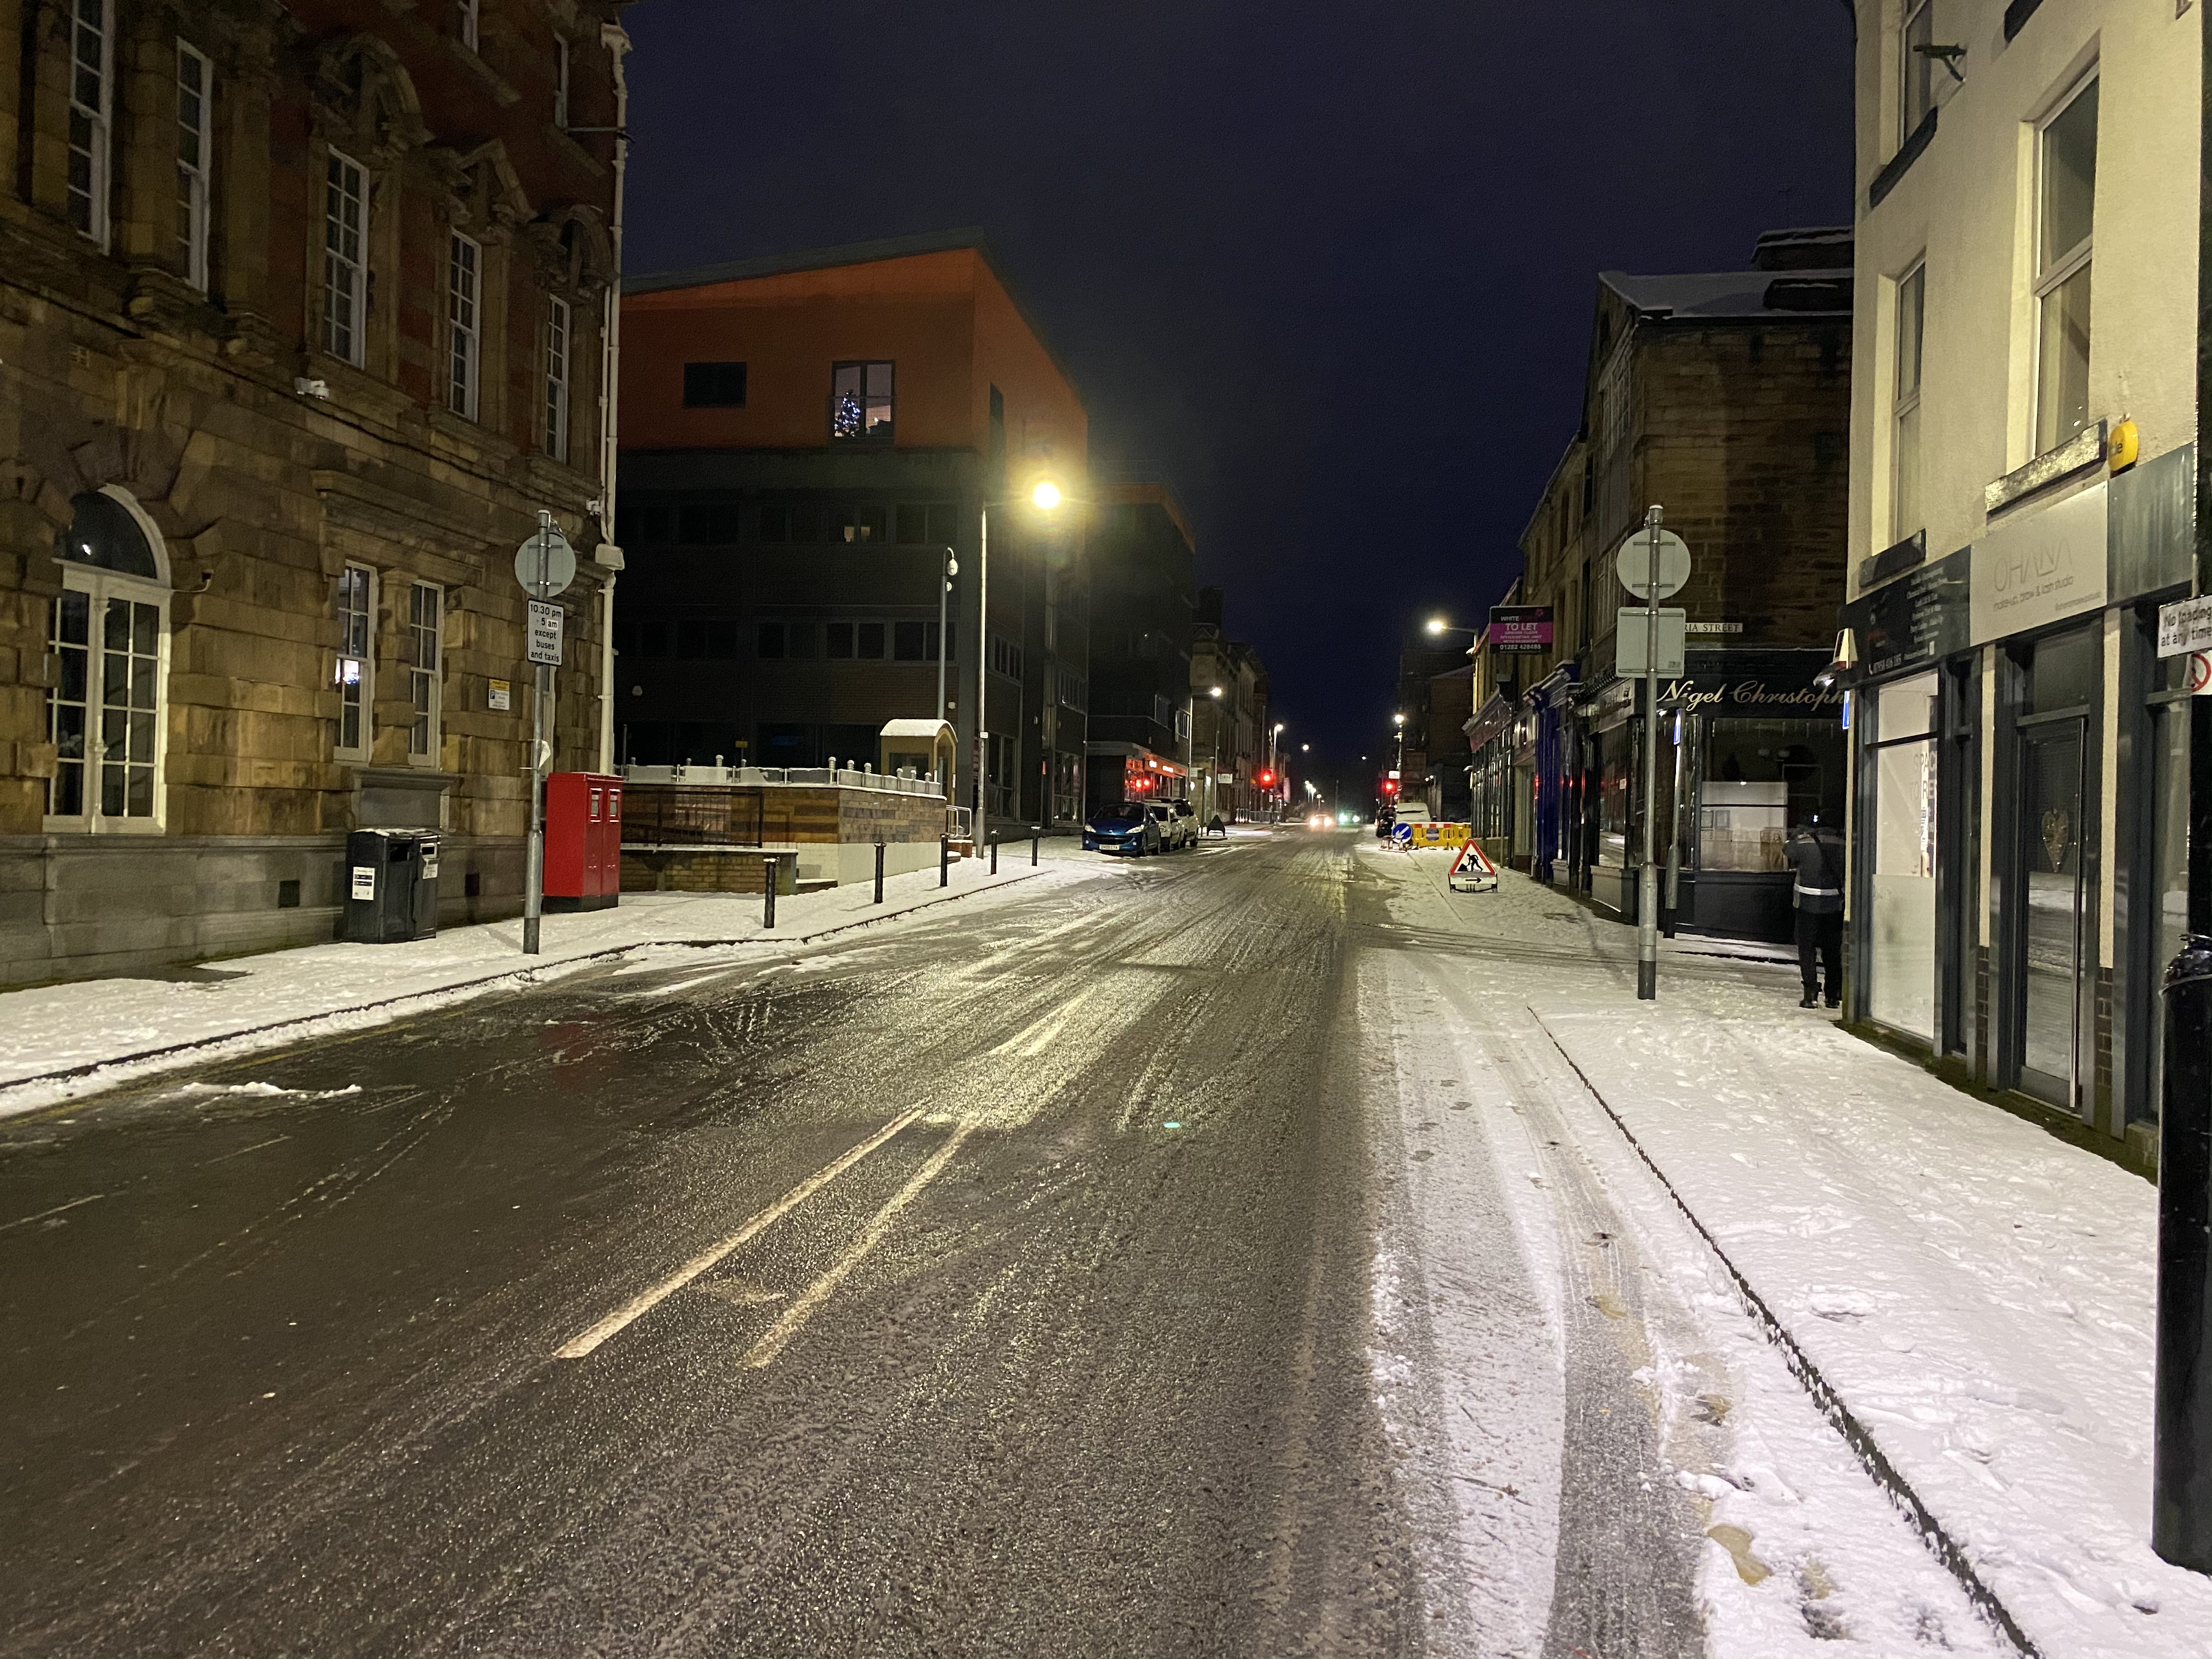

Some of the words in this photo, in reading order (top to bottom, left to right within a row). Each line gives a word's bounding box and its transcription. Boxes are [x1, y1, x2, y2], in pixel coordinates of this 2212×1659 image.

[2164, 612, 2176, 627] No
[2178, 606, 2211, 625] loading
[535, 629, 556, 639] except
[1521, 622, 1538, 630] LET
[536, 639, 555, 650] buses
[2160, 633, 2170, 647] at
[2172, 632, 2187, 646] any
[2192, 626, 2211, 641] time
[545, 652, 560, 662] taxis
[1656, 680, 1727, 712] Nigel
[1729, 680, 1844, 712] Christoph
[1914, 751, 1937, 774] SPAC
